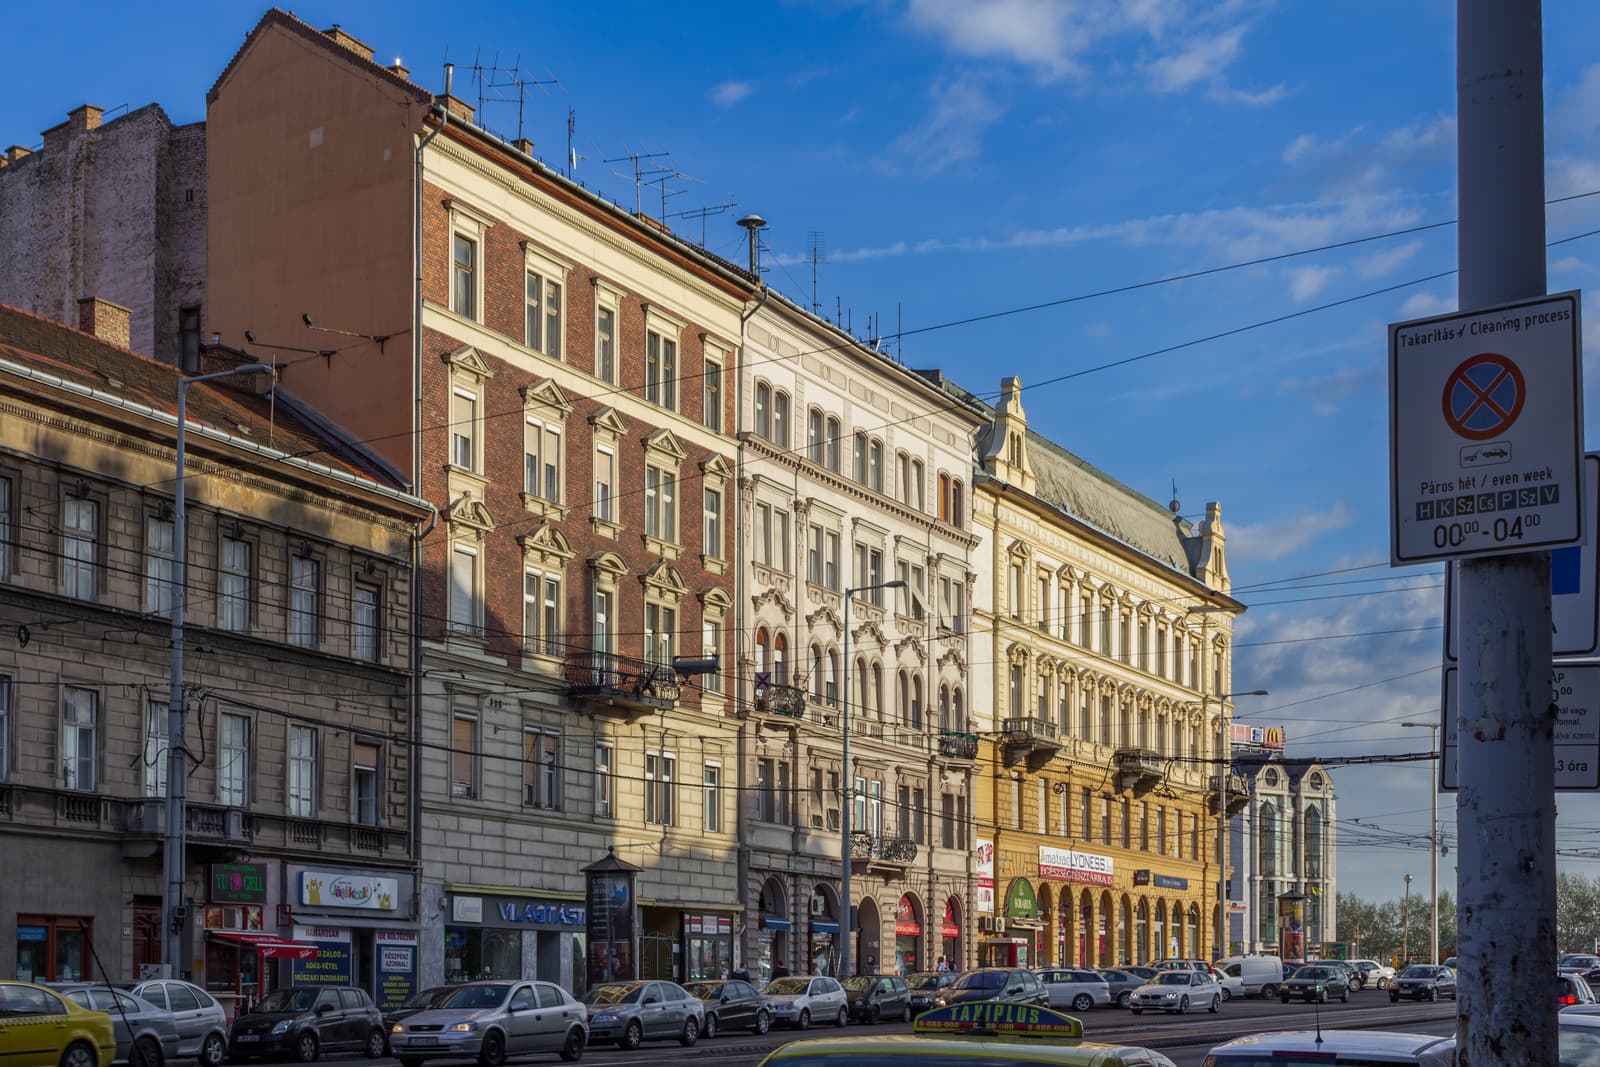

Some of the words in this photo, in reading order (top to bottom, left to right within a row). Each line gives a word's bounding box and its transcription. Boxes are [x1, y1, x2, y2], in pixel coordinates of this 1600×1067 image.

[1471, 317, 1520, 336] Cleaning
[1525, 309, 1570, 328] process
[1421, 481, 1454, 496] Páros
[1458, 476, 1476, 491] hét
[1492, 473, 1519, 486] even
[1523, 466, 1553, 482] week
[1420, 503, 1430, 517] H
[1440, 501, 1451, 515] K
[1458, 499, 1473, 514] Sz
[1479, 496, 1494, 511] Cs
[1502, 494, 1512, 508] P
[1520, 491, 1536, 505] Sz
[1544, 487, 1556, 502] V
[1568, 759, 1588, 772] óra
[1071, 853, 1106, 871] LYONESS
